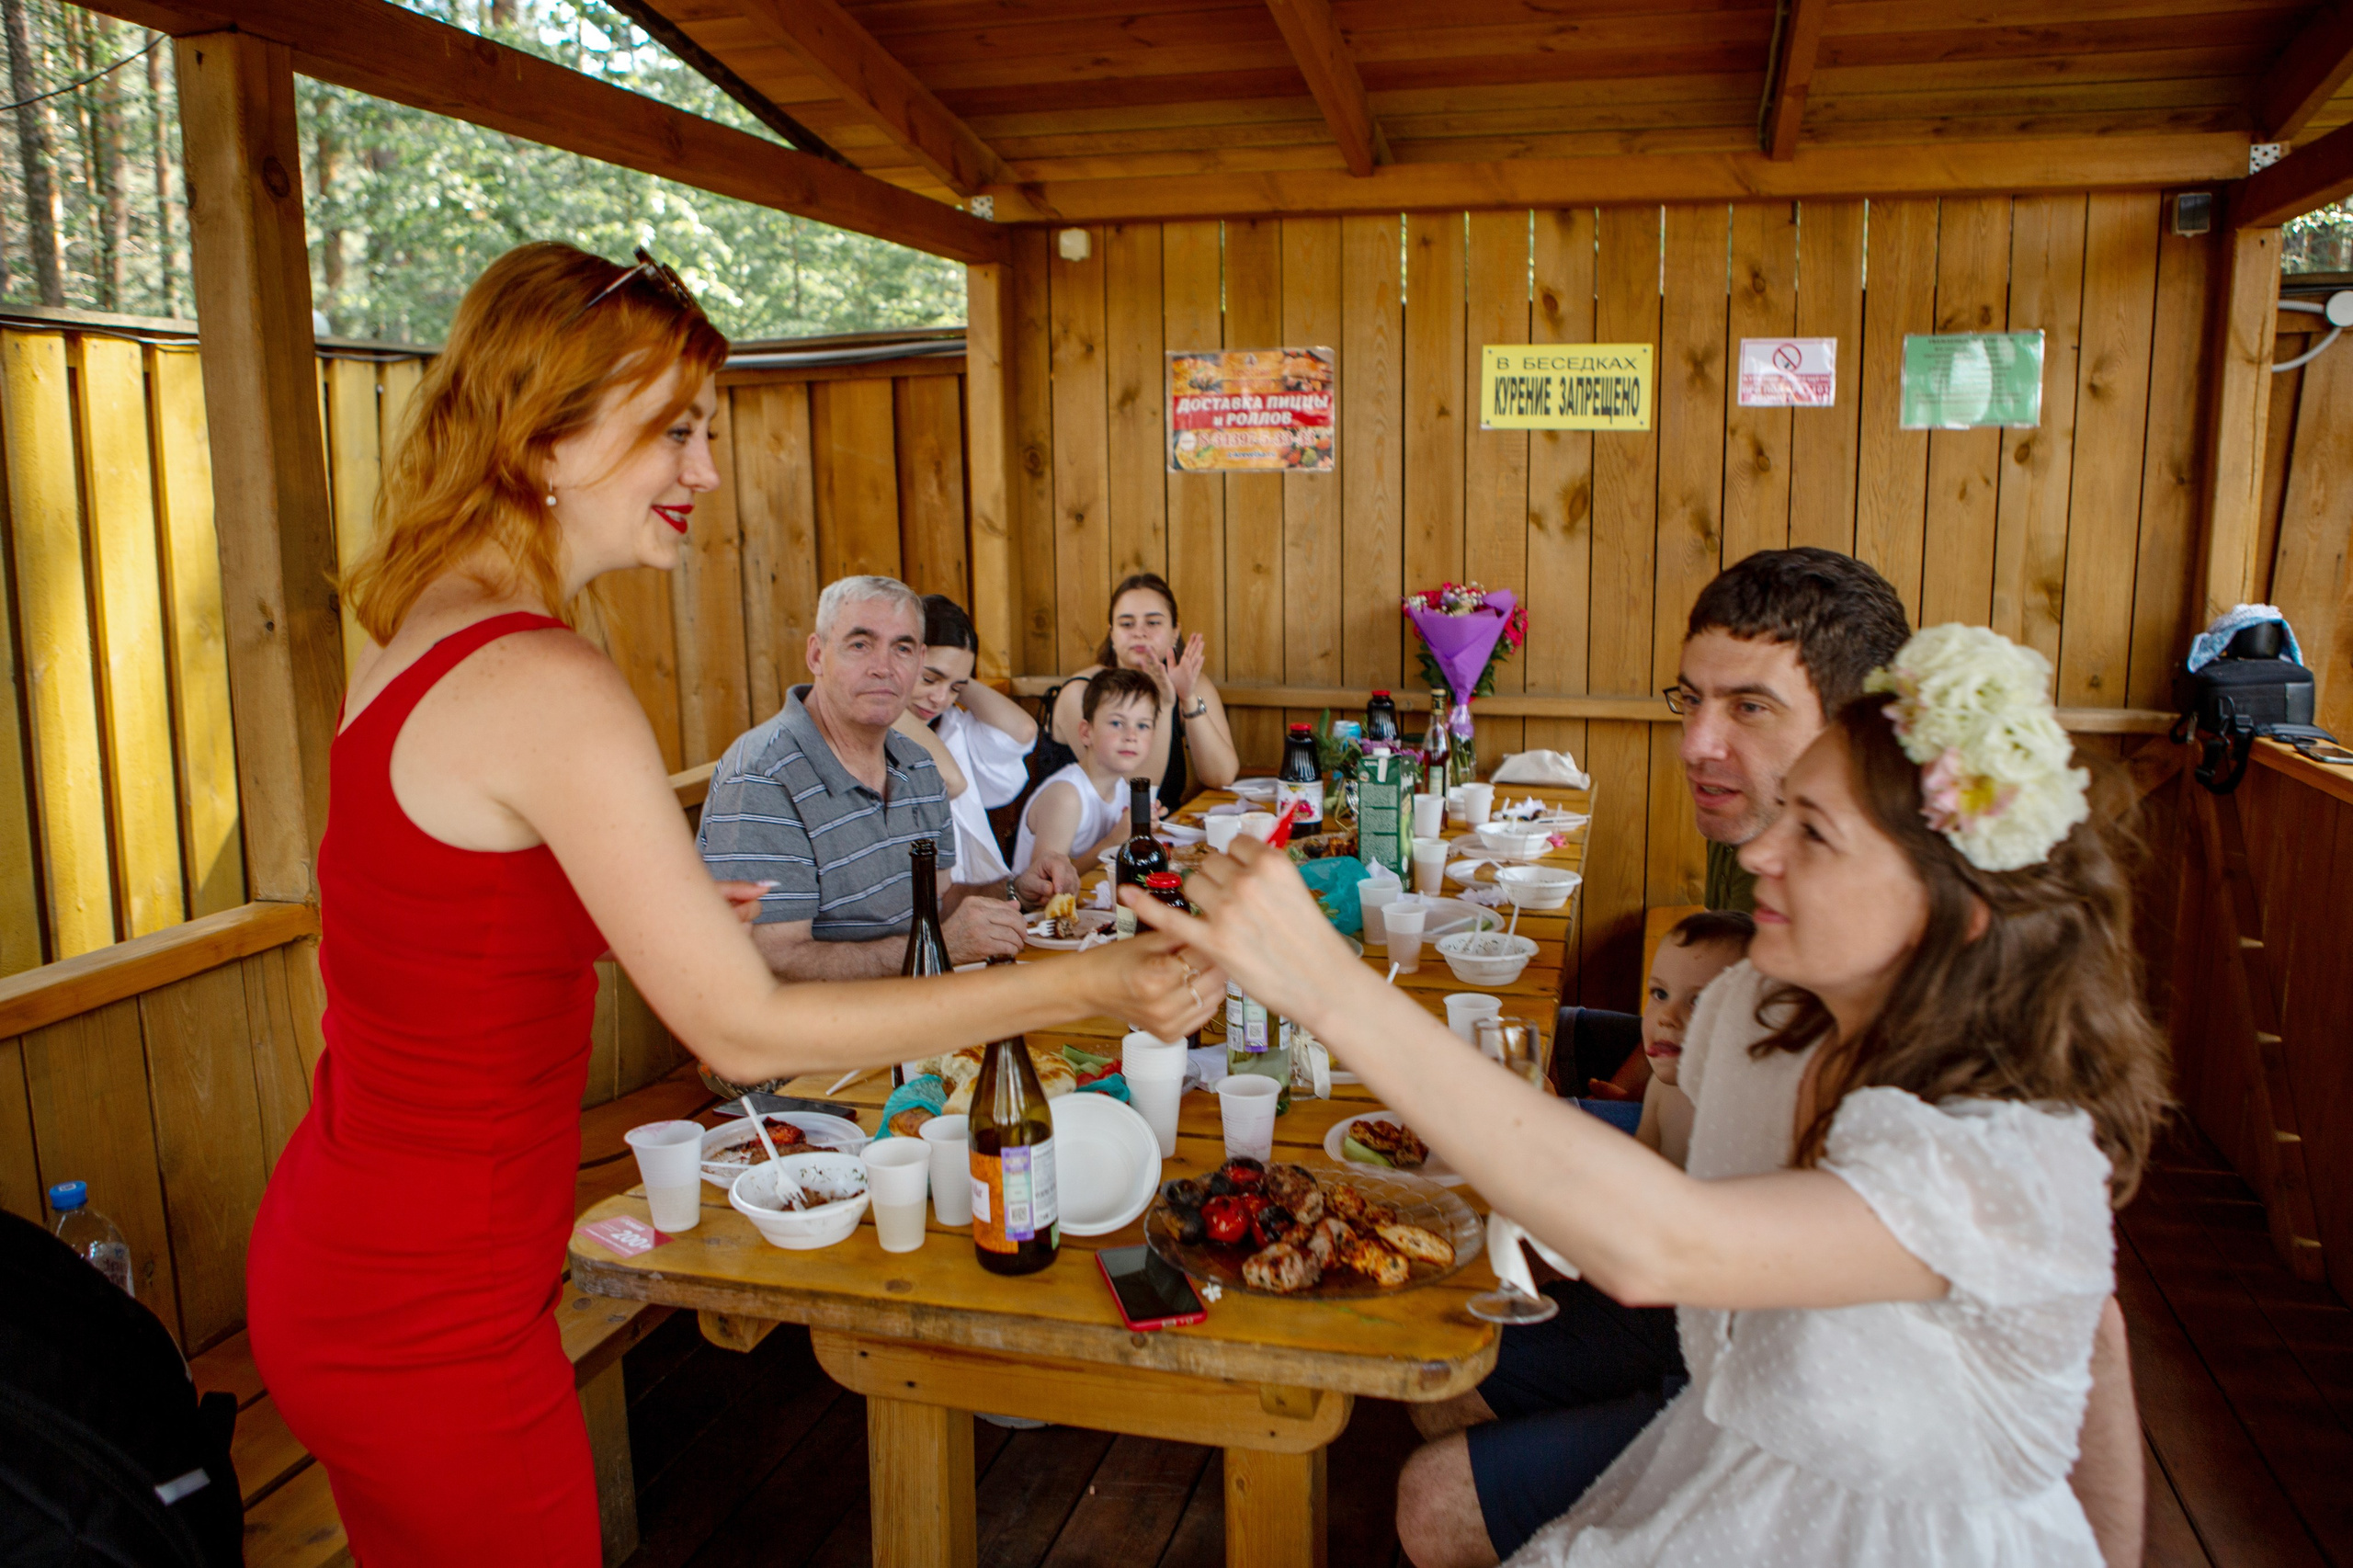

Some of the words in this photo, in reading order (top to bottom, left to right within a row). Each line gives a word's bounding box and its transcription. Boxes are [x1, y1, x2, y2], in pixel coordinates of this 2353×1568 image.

[1496, 357, 1510, 370] В
[1523, 356, 1638, 372] БЕСЕДКАХ
[1177, 396, 1262, 413] ДОСТАВКА
[1267, 395, 1329, 410] ПИЦЦЫ
[1494, 376, 1552, 415] КУРЕНИЕ
[1558, 375, 1641, 424] ЗАПРЕЩЕНО
[1225, 411, 1293, 426] РОЛЛОВ
